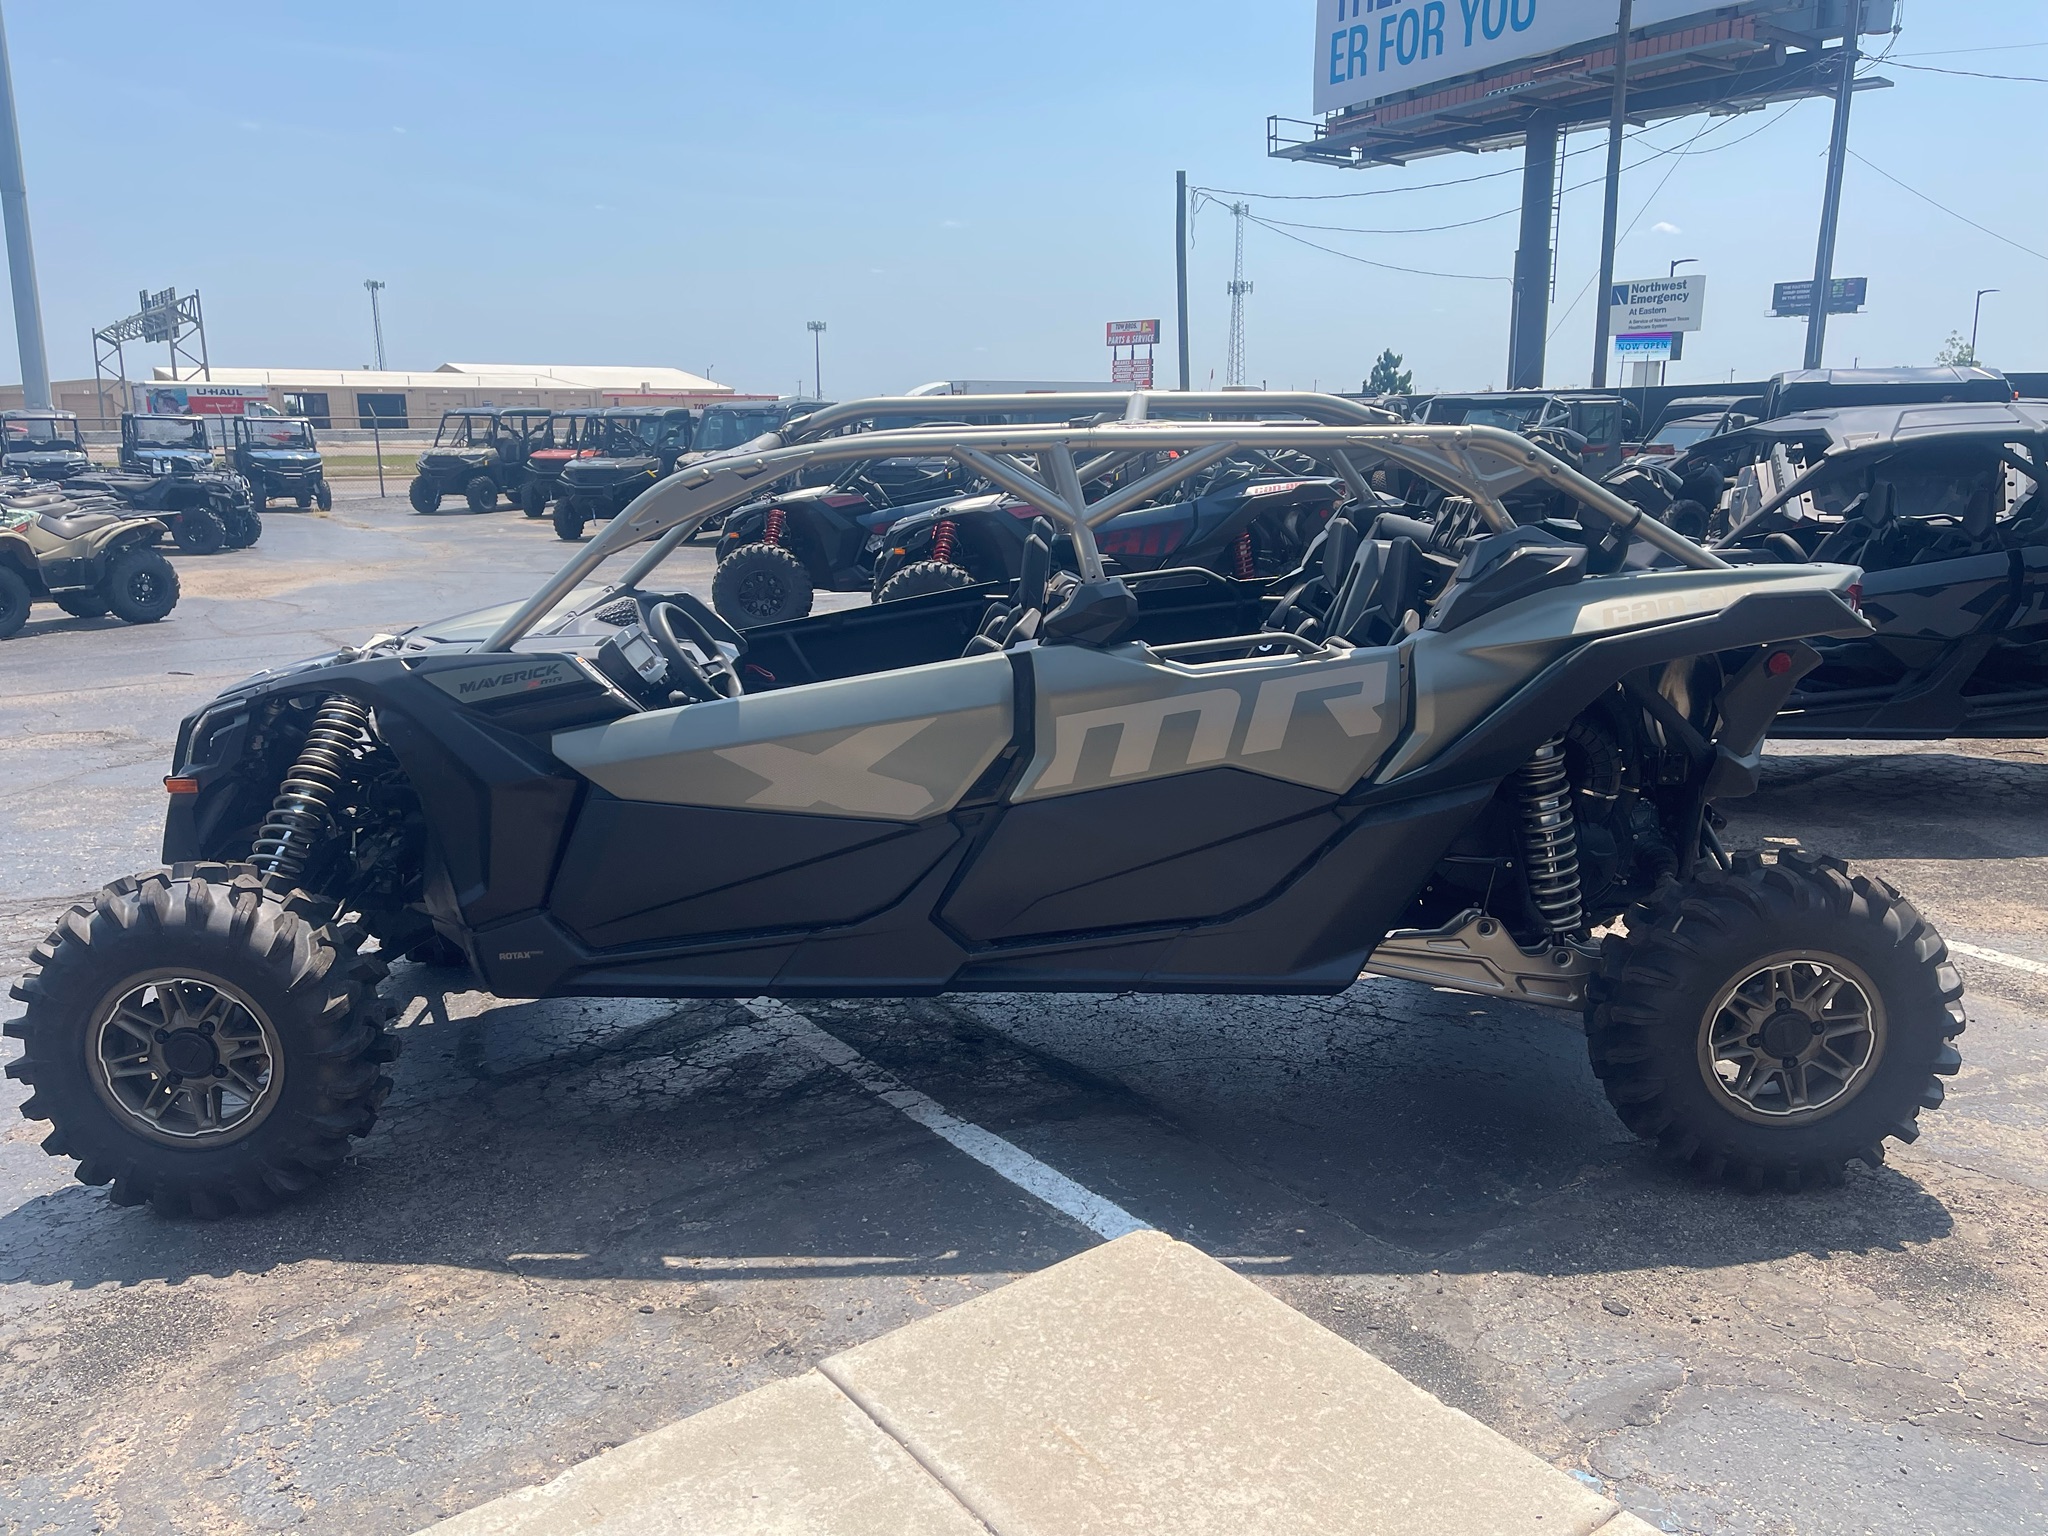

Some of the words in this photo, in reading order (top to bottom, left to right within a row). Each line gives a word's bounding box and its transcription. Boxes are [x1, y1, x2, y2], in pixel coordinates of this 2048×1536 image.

[1330, 24, 1368, 85] ER
[1379, 1, 1446, 72] FOR
[1461, 0, 1536, 47] YOU
[1631, 280, 1688, 294] Northwest
[1630, 292, 1689, 305] Emergency
[1629, 308, 1637, 316] At
[1639, 307, 1667, 315] Eastern
[1108, 335, 1125, 345] PARTS
[1126, 336, 1131, 344] &
[1132, 334, 1154, 344] SERVICE
[1618, 342, 1640, 351] NOW
[1643, 341, 1668, 350] OPEN
[196, 388, 243, 396] U-HAUL
[459, 663, 560, 694] MAVERICK
[498, 951, 530, 960] ROTAX
